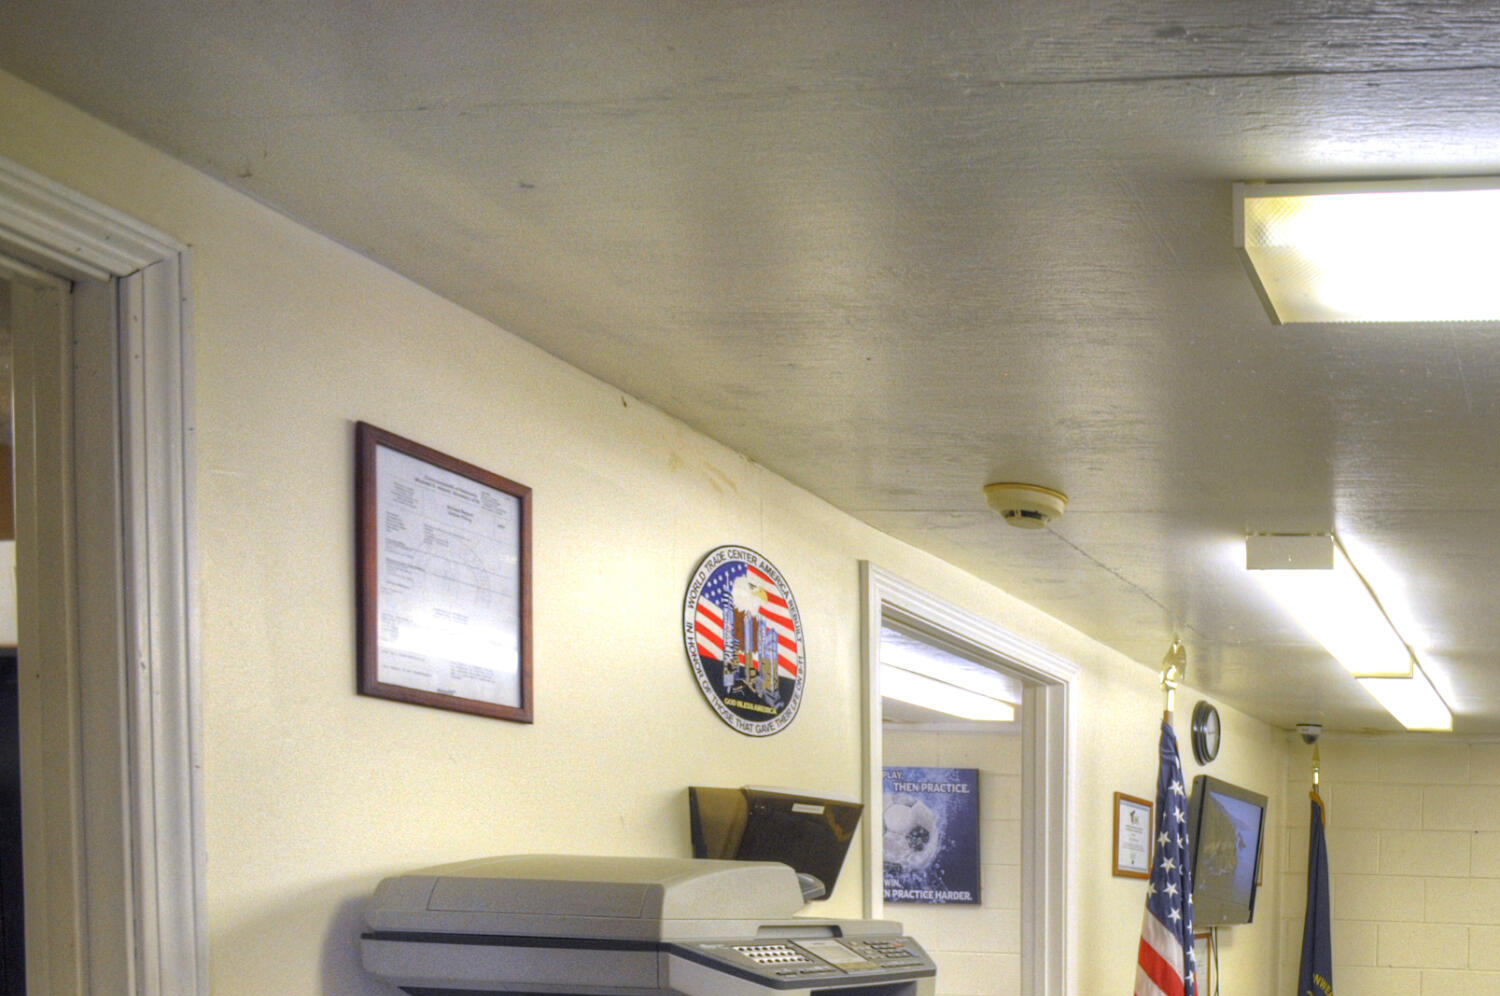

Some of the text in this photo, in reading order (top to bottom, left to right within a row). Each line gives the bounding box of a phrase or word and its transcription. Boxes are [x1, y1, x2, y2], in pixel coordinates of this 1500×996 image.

[687, 572, 707, 609] WORLD
[704, 551, 727, 573] TRADE
[727, 549, 758, 566] CENTER
[758, 561, 790, 599] AMERICA
[686, 634, 705, 680] HONOR
[711, 692, 735, 725] THOSE
[735, 718, 753, 732] THAT
[754, 721, 776, 734] GAVE
[774, 708, 793, 727] THEIR
[893, 782, 970, 794] THEN PRACTICE.
[892, 889, 934, 900] PRACTICE
[935, 890, 973, 901] HARDER.
